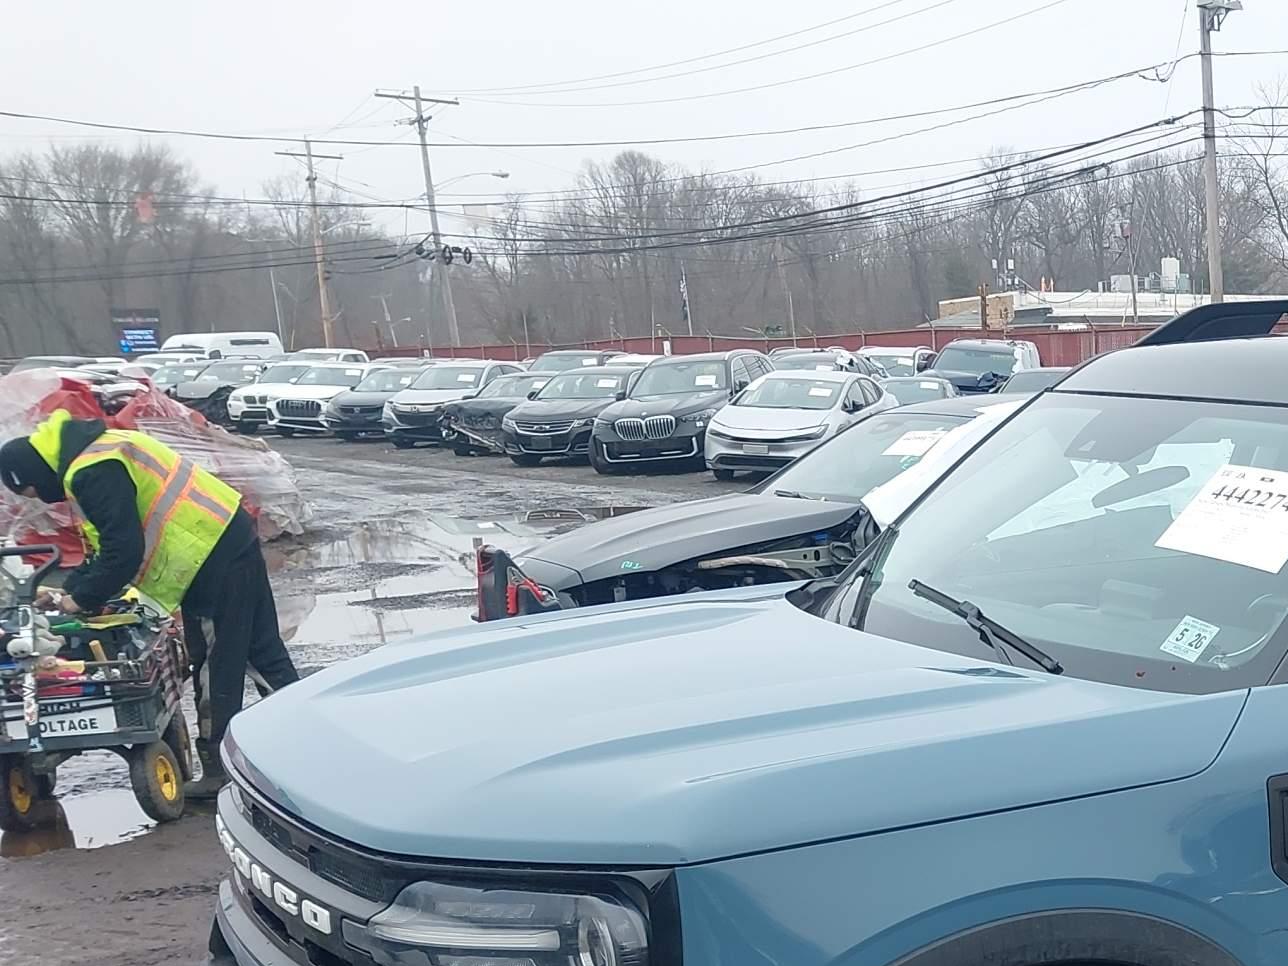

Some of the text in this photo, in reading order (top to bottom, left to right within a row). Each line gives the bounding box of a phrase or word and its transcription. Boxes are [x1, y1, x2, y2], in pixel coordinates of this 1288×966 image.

[1175, 627, 1190, 642] 5
[1187, 632, 1207, 650] 26
[39, 717, 99, 733] OLTAGE
